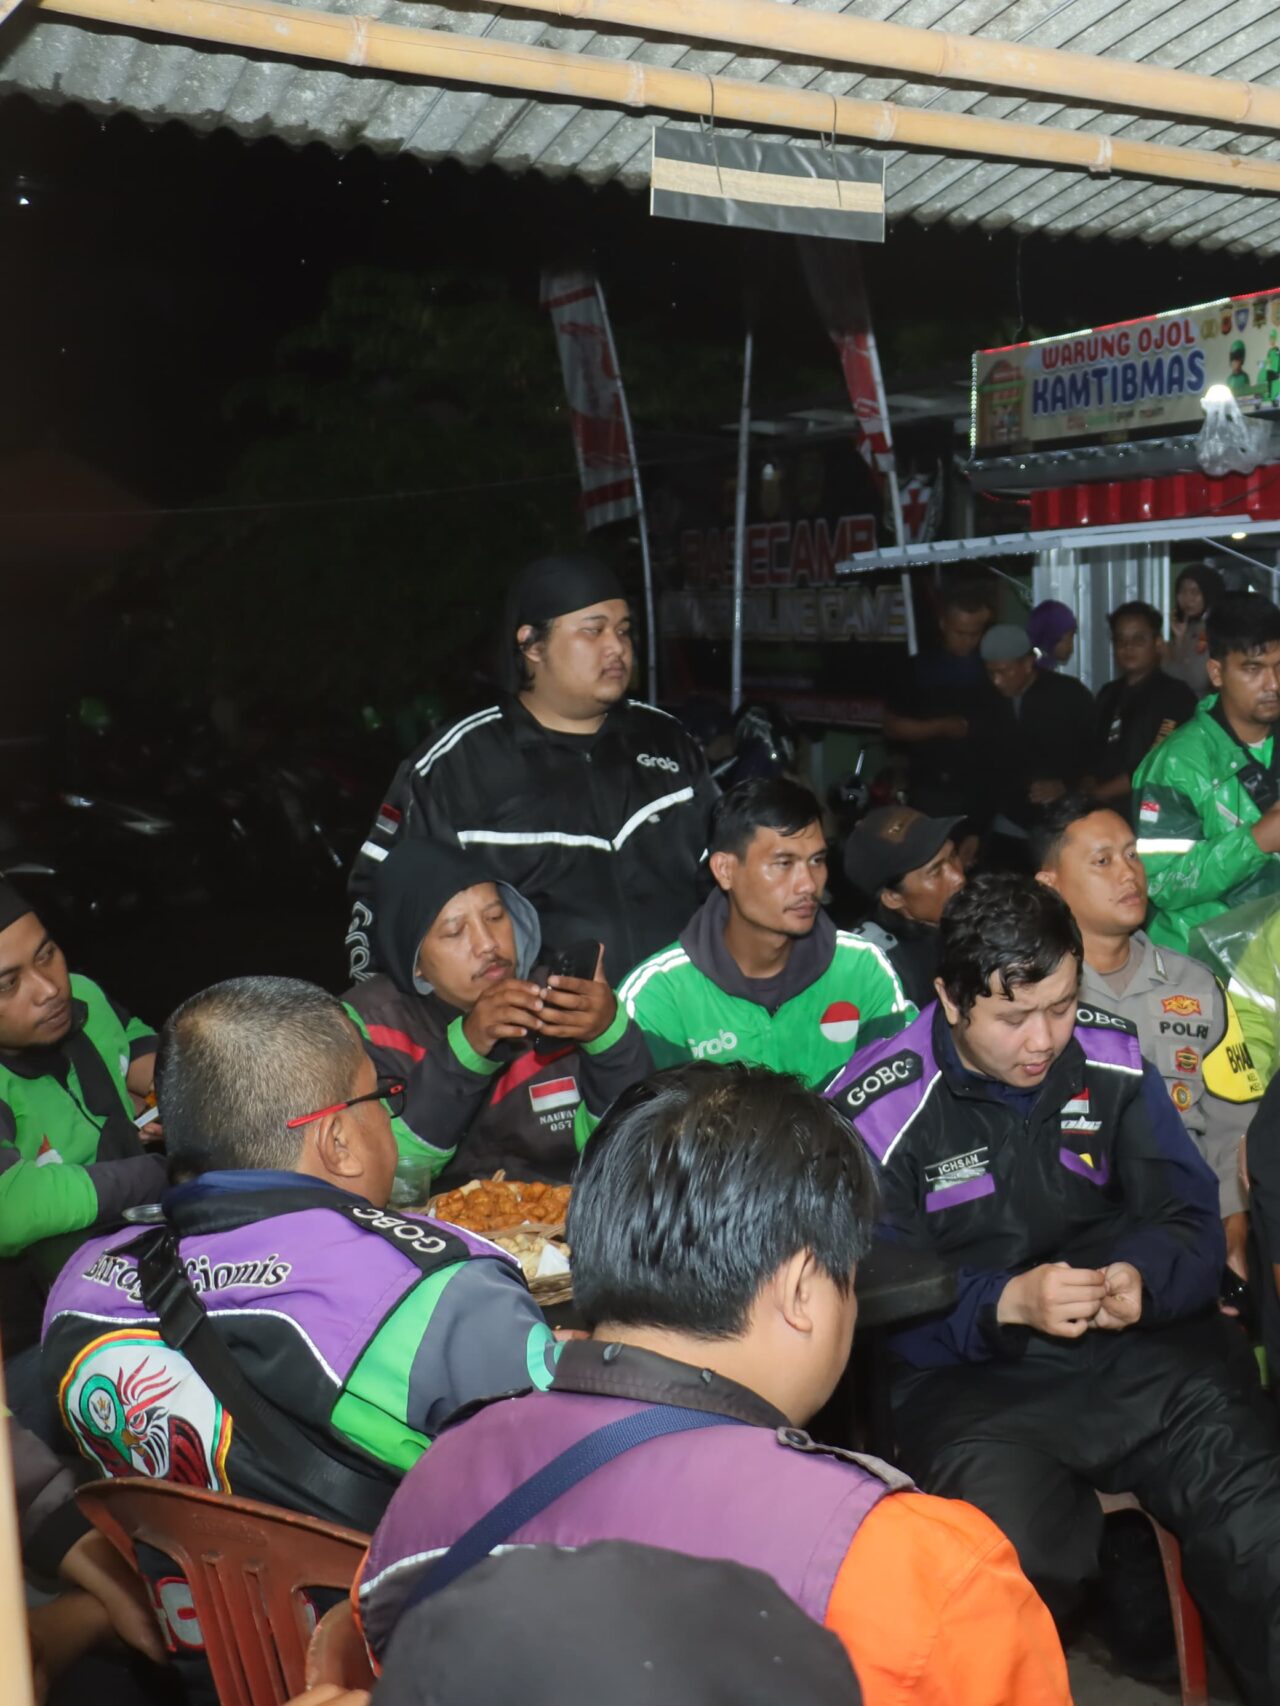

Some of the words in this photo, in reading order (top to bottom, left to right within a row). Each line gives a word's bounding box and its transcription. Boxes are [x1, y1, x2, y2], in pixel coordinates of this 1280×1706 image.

[1041, 331, 1131, 370] WARUNG
[1138, 318, 1196, 350] OJOL
[1032, 350, 1204, 416] KAMTIBMAS
[636, 753, 680, 773] Grab
[847, 1060, 909, 1106] GOBC
[937, 1153, 979, 1175] ICHSAN
[352, 1207, 447, 1253] GOBC
